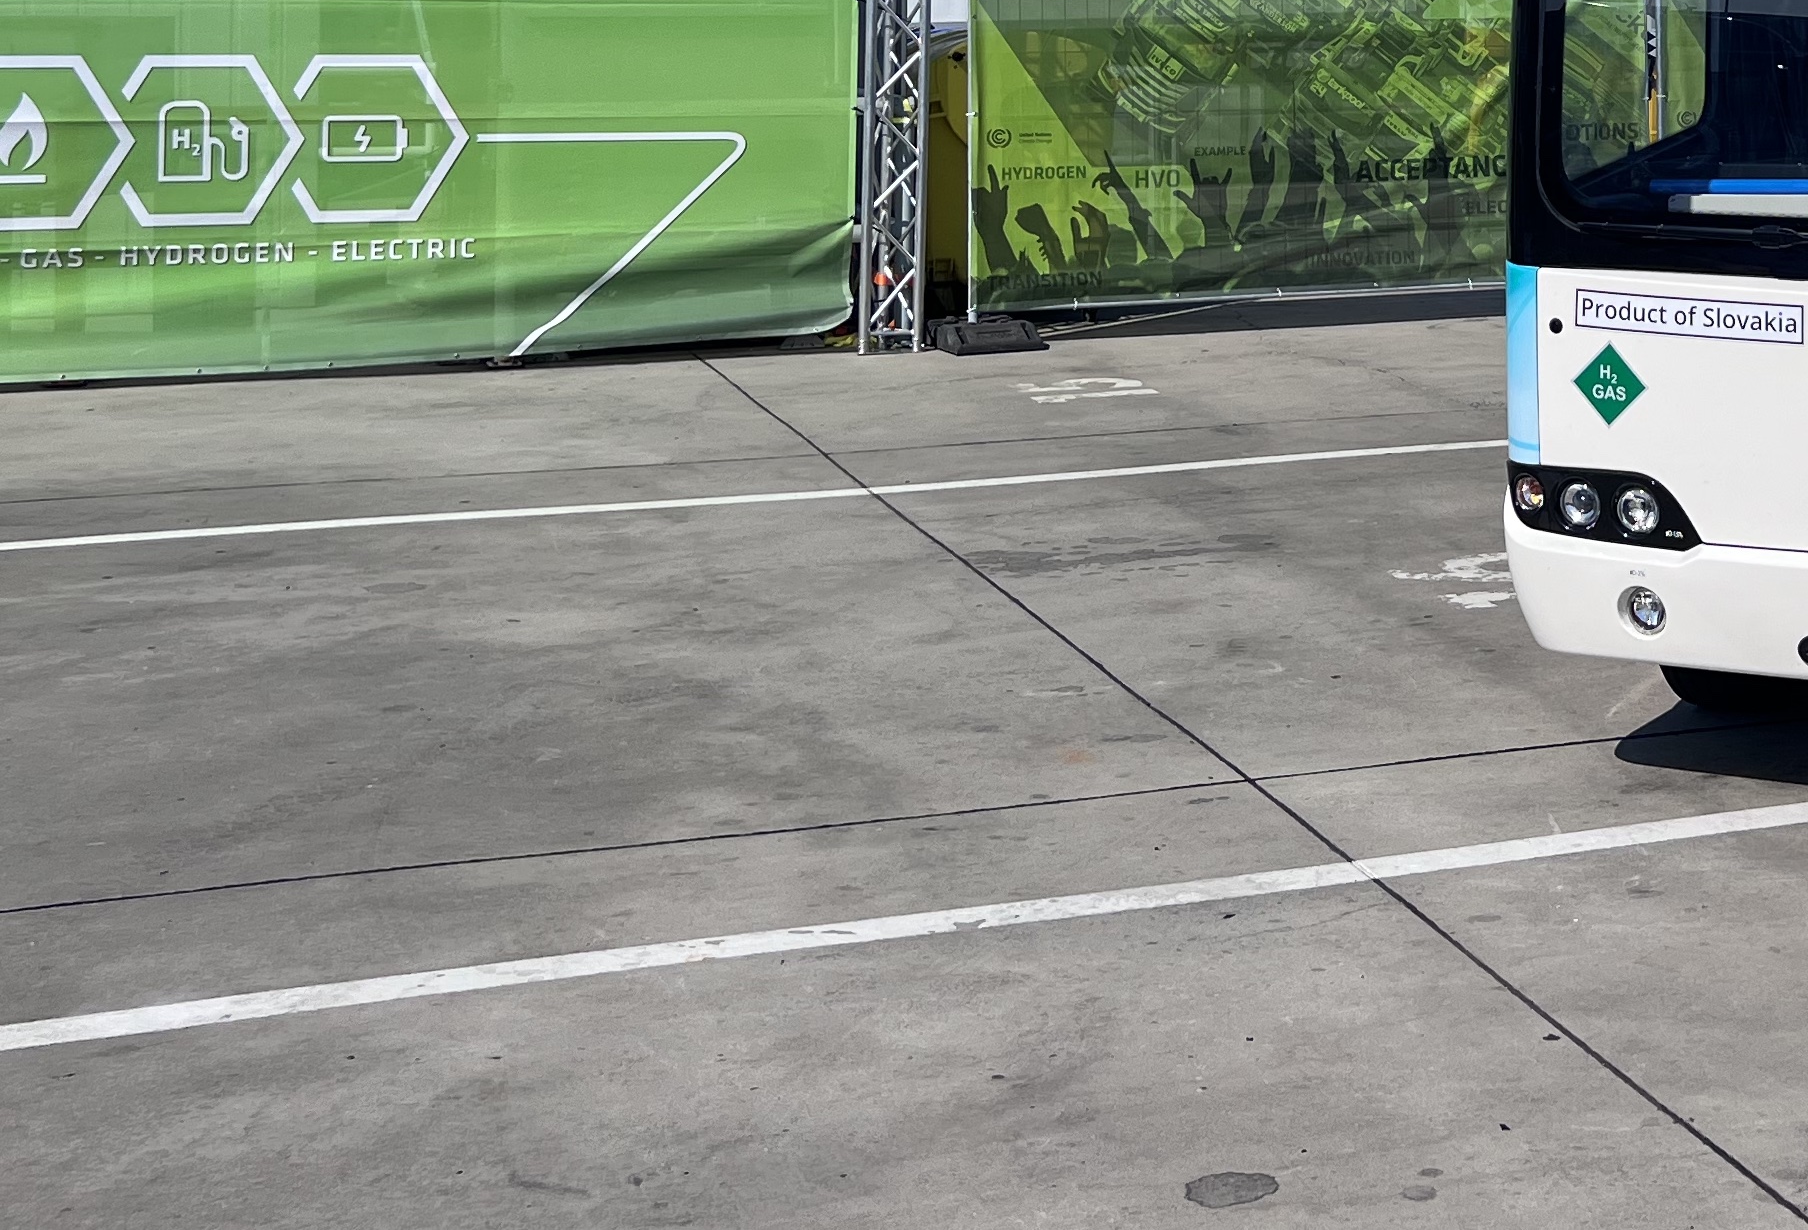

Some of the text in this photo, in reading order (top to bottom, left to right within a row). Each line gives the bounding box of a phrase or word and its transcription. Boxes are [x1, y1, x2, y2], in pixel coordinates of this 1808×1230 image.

[1194, 145, 1247, 157] EXAMPLE
[1001, 164, 1181, 189] HYDROGEN HVO
[19, 247, 84, 269] GAS
[119, 241, 295, 267] HYDROGEN
[331, 237, 477, 262] ELECTRIC
[1310, 250, 1416, 268] INNOVATION
[987, 271, 1103, 291] TRANSITION
[1581, 297, 1798, 334] Product of Slovakia
[1592, 383, 1626, 402] GAS
